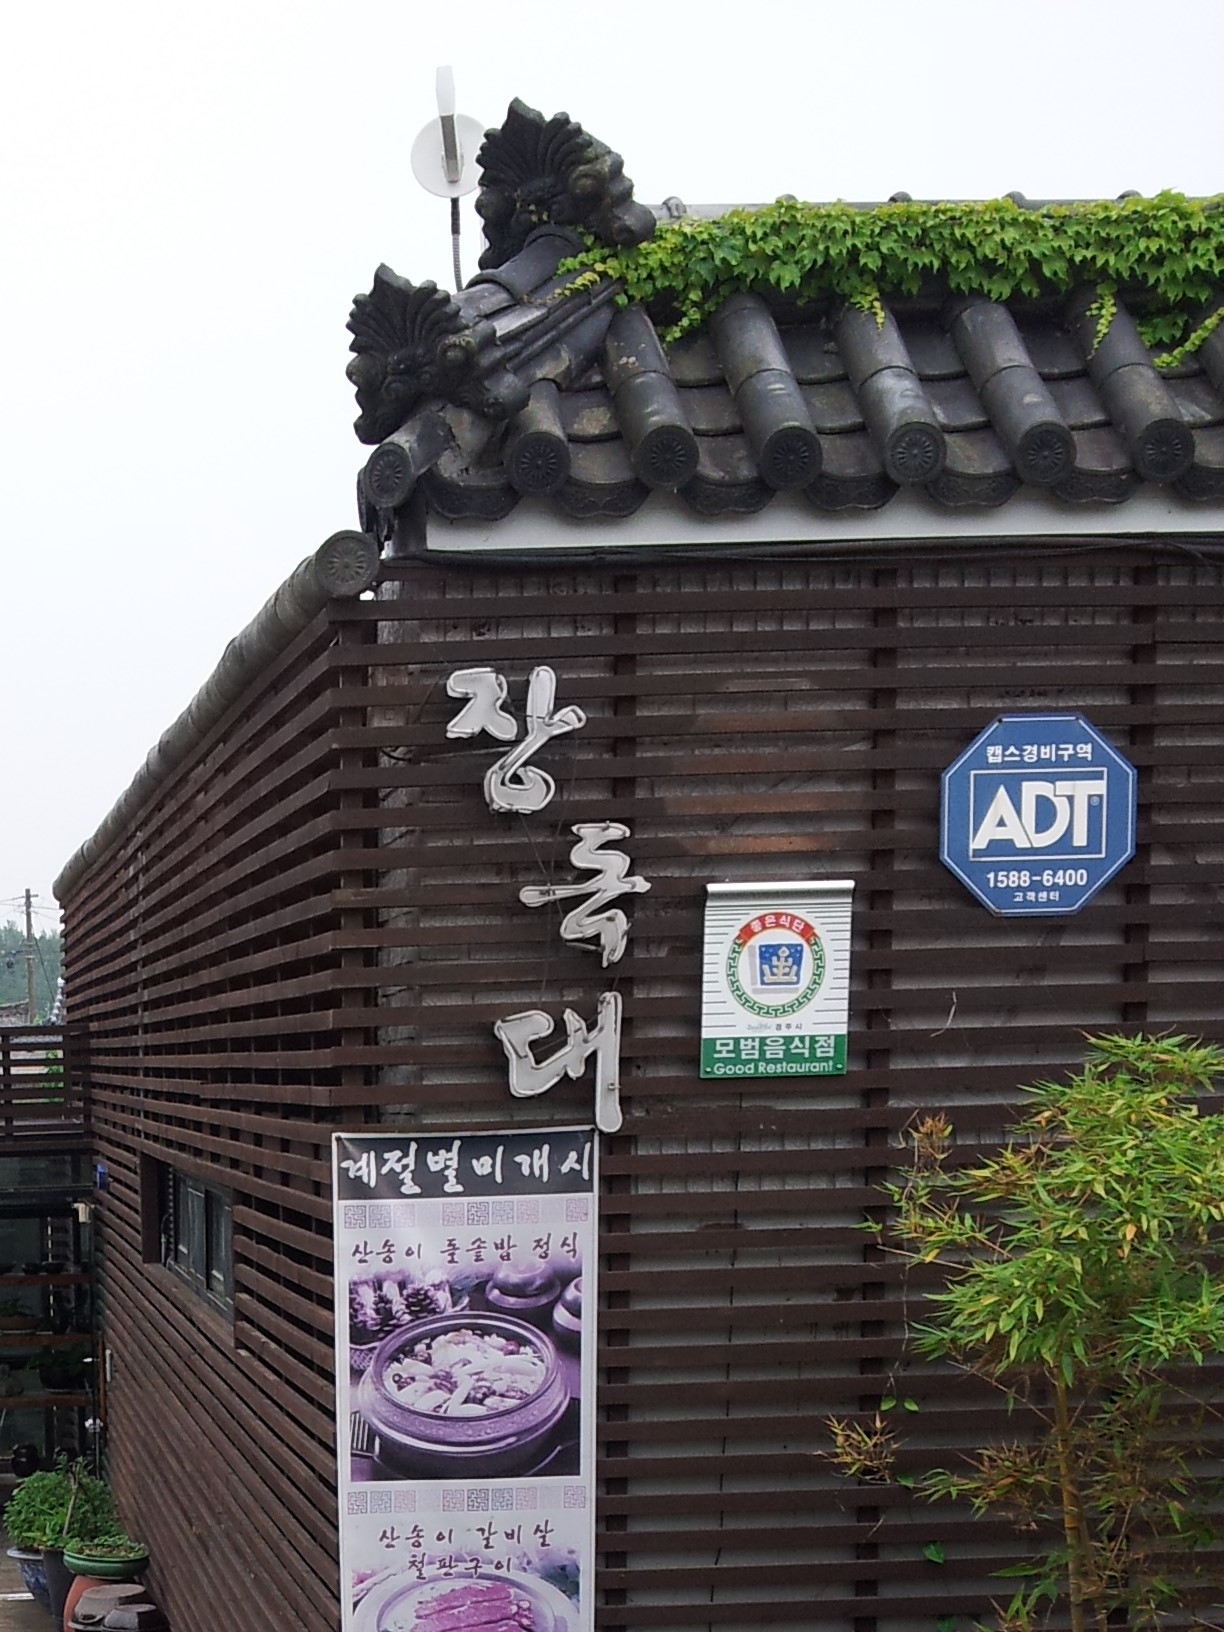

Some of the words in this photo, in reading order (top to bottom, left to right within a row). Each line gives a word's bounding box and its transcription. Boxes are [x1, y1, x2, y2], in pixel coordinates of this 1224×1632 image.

[986, 743, 1092, 764] 캡스경비구역
[972, 780, 1105, 849] ADT
[986, 869, 1088, 888] 1588-6400
[446, 665, 652, 1134] 장독대
[1013, 891, 1060, 902] 고객센터
[713, 1035, 836, 1060] 모범음식점
[713, 1062, 755, 1075] Good
[758, 1060, 834, 1074] Restaurant
[351, 1238, 422, 1264] 산송이
[532, 1232, 580, 1260] 정식
[378, 1524, 454, 1549] 산송이
[475, 1519, 555, 1550] 갈비살
[408, 1552, 512, 1581] 철판구이
